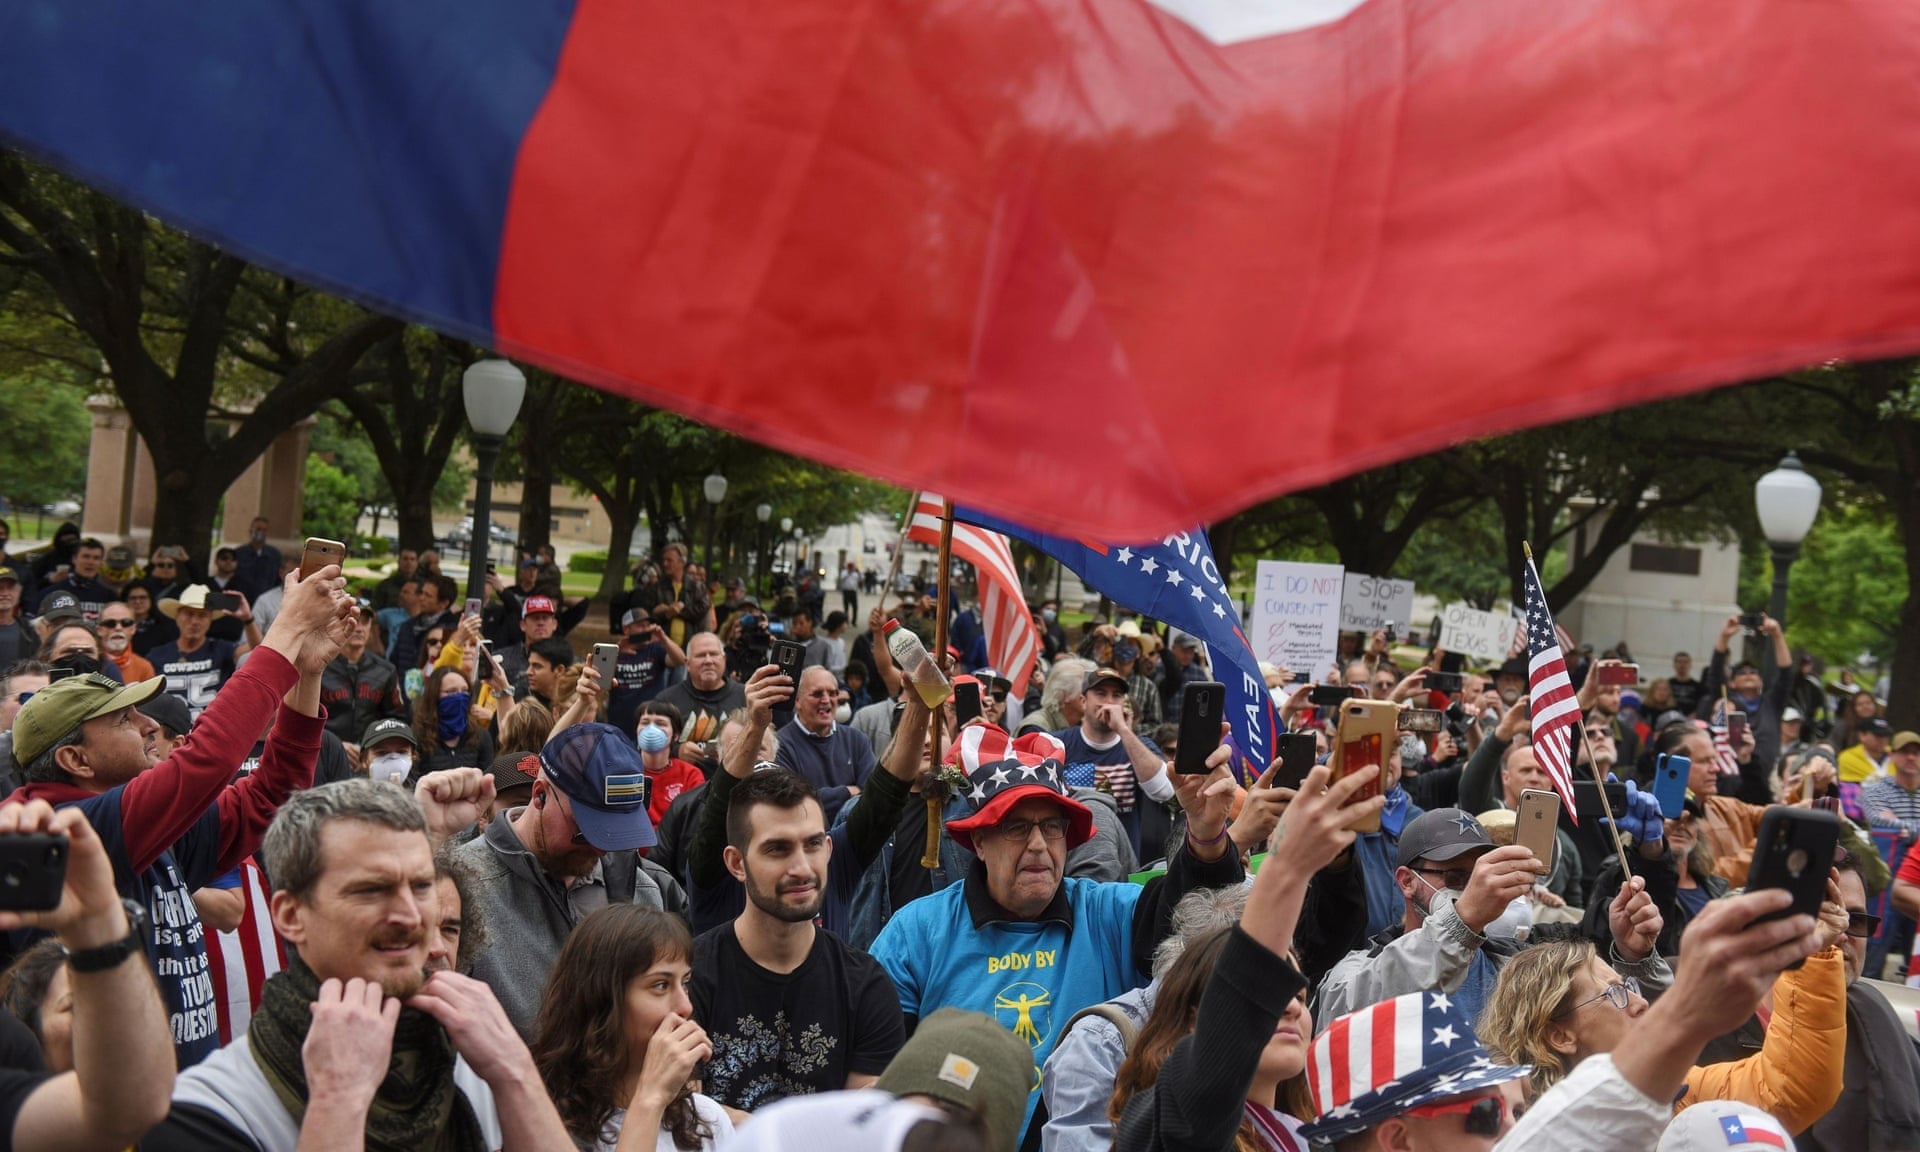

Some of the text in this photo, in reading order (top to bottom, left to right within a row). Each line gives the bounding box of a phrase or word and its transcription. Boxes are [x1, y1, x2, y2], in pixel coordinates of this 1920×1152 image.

[1264, 574, 1341, 595] I DO NOT
[1359, 578, 1405, 600] STOP
[1265, 599, 1328, 615] CONSENT
[1448, 607, 1487, 628] OPEN
[1444, 624, 1489, 654] TEXAS
[163, 658, 214, 674] COWBOYS
[617, 661, 654, 673] TRUMP
[988, 949, 1057, 974] BODY BY
